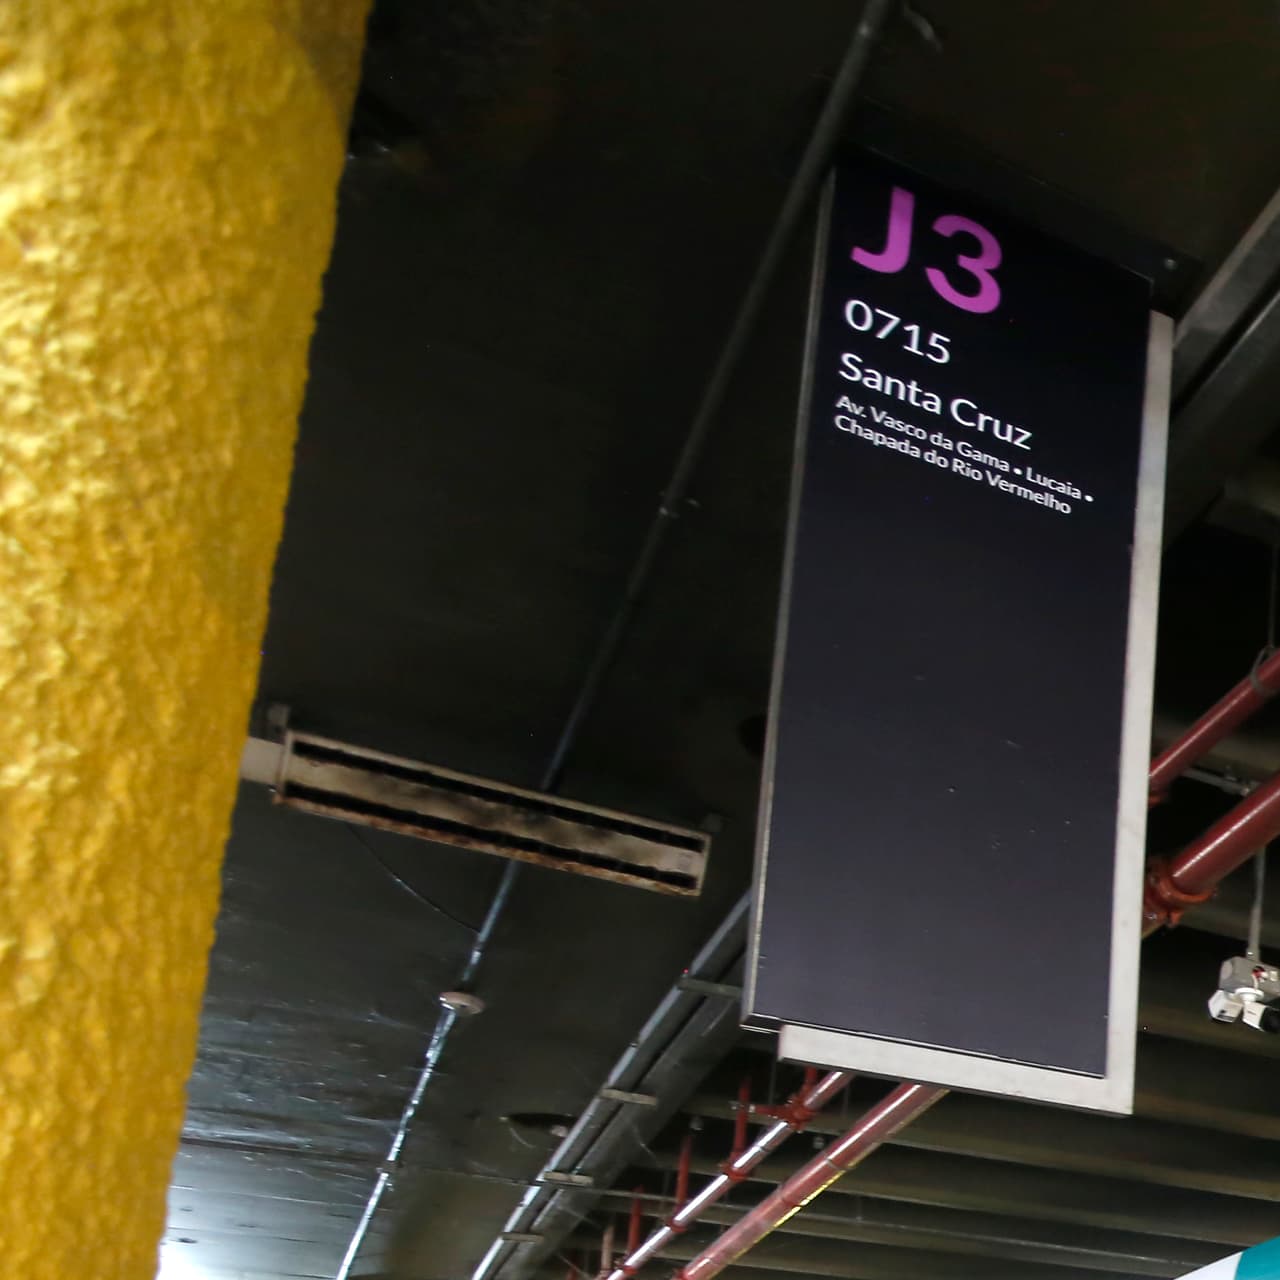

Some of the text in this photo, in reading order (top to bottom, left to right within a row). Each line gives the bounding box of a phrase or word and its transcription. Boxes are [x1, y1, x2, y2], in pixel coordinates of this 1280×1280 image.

[850, 186, 1003, 313] J3
[845, 299, 951, 364] 0715
[835, 395, 1082, 500] Av. Vasco da Gama Lucaia
[839, 352, 1033, 451] Santa Cruz
[834, 414, 1072, 515] Chapada do Rio Vermelho
